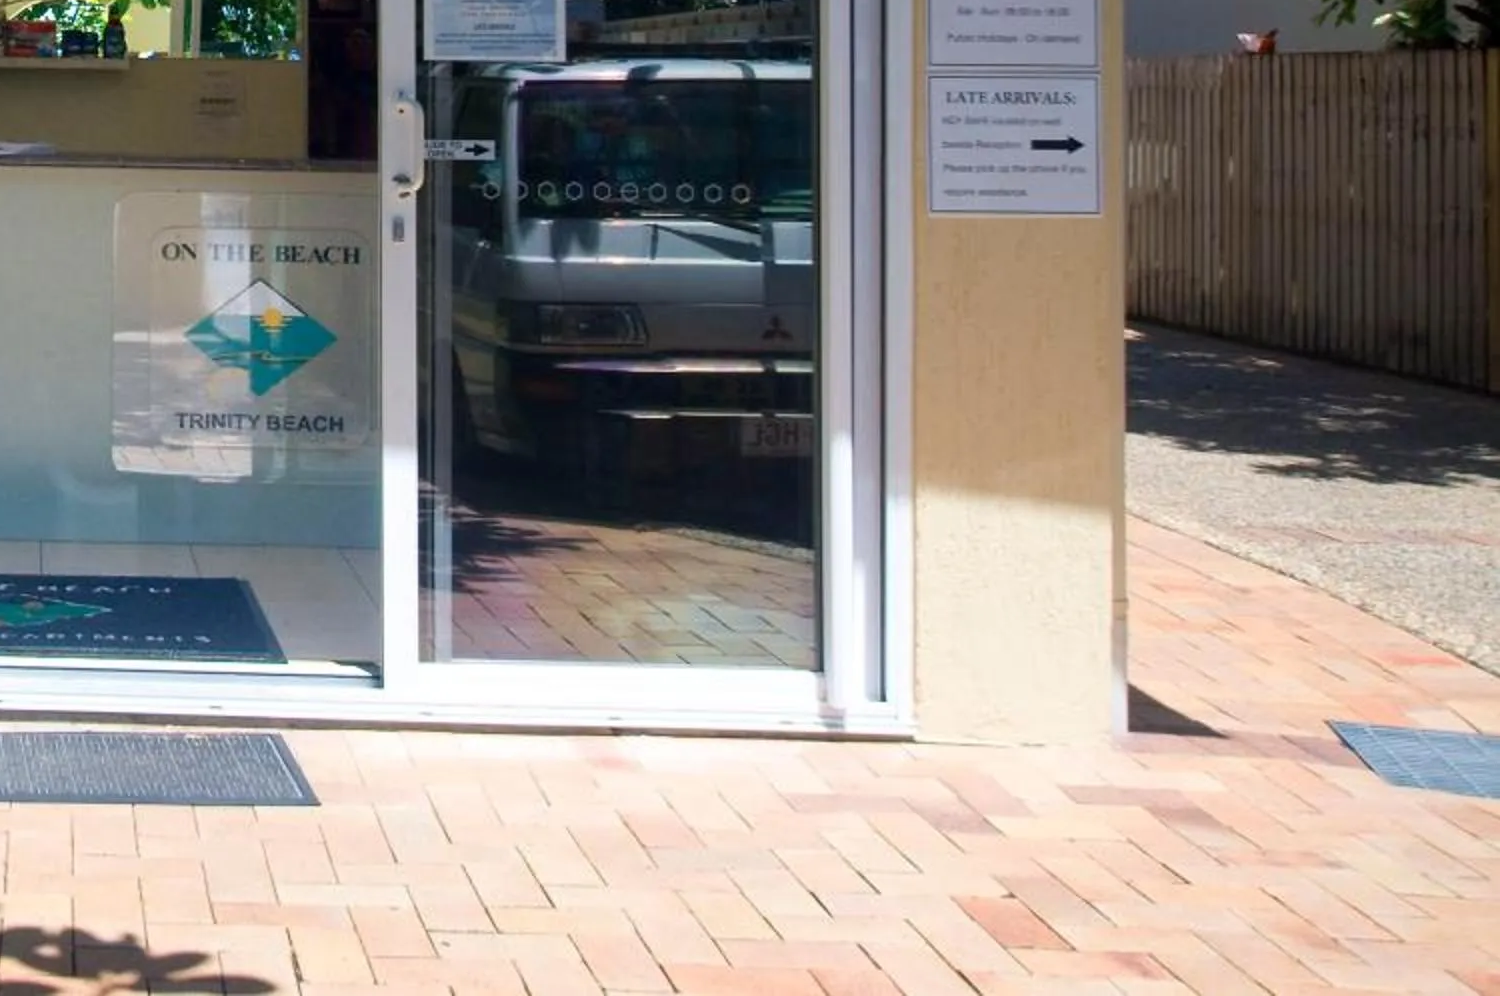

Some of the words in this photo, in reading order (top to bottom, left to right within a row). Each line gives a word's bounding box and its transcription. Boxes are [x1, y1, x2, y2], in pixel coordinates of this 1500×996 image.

[946, 90, 988, 104] LATE
[991, 91, 1077, 106] ARRIVALS:
[161, 242, 198, 261] ON
[207, 243, 265, 263] THE
[275, 245, 361, 265] BEACH
[175, 411, 261, 432] TRINITY
[266, 415, 345, 434] BEACH
